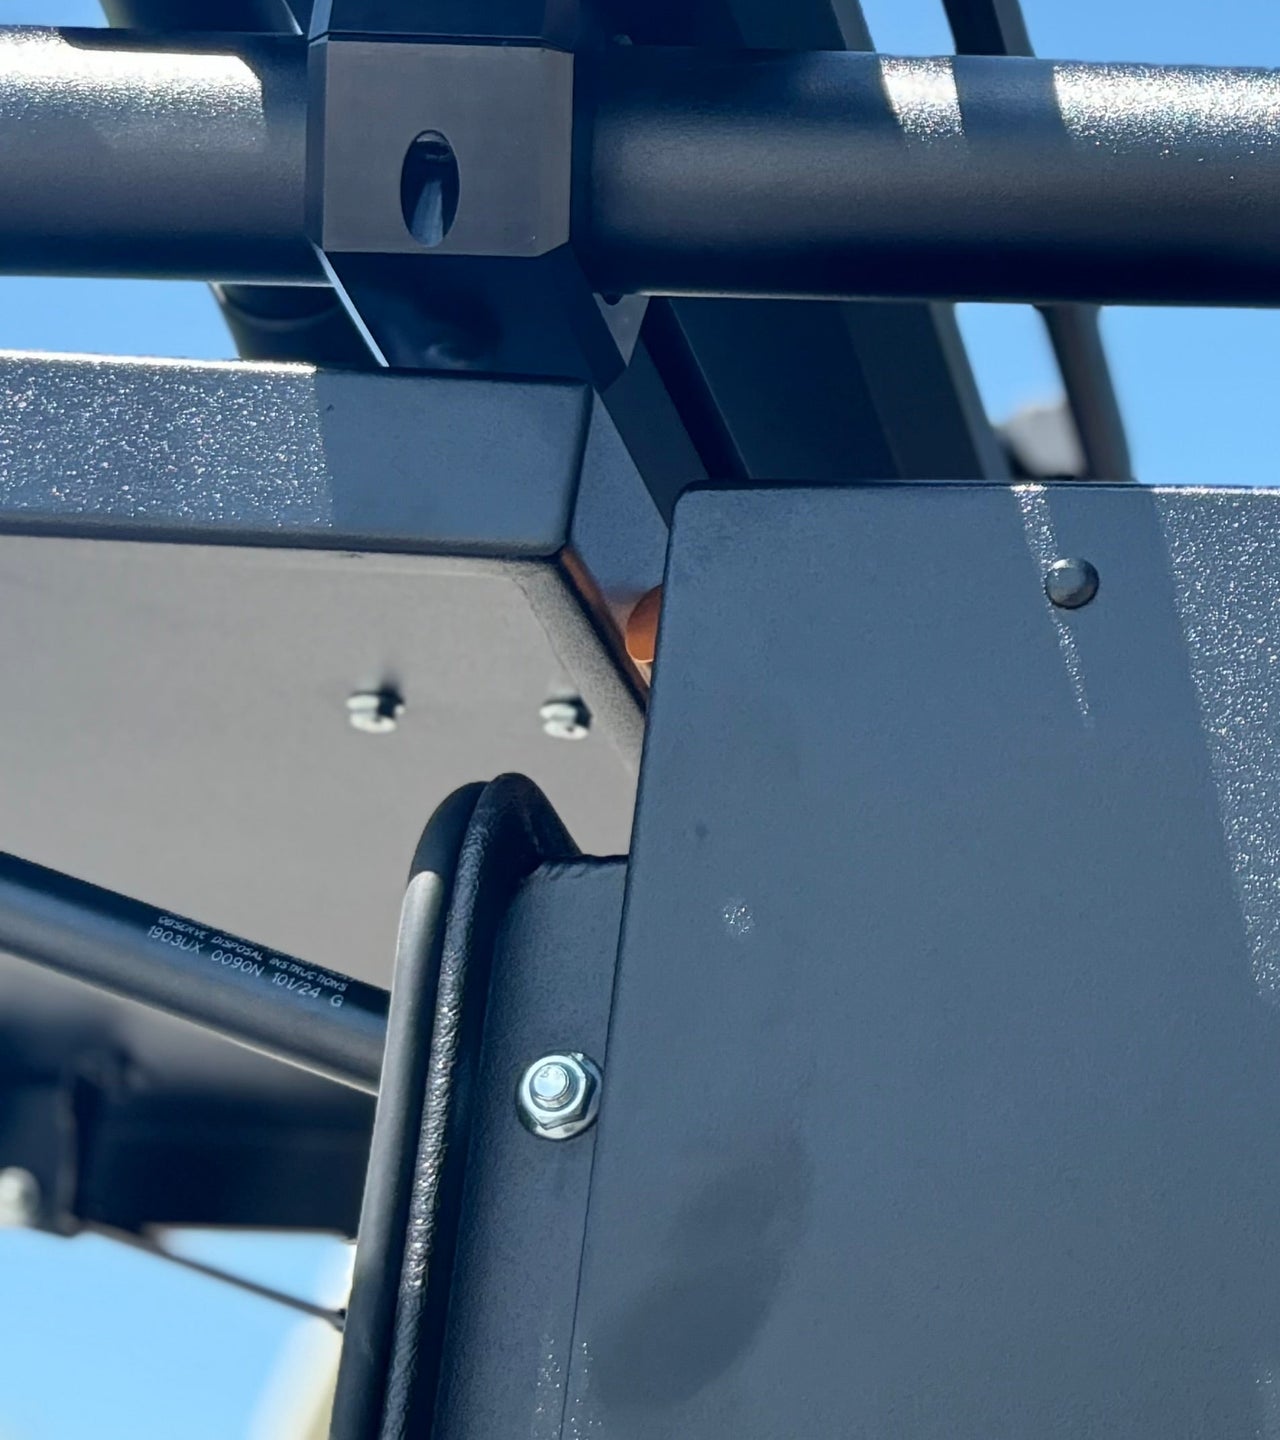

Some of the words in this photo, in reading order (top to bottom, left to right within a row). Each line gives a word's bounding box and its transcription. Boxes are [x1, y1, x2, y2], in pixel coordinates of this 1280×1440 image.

[147, 924, 206, 955] 1903UX
[211, 949, 265, 977] 0090N
[330, 994, 344, 1008] G
[158, 915, 209, 940] OBSERVE
[211, 935, 264, 961] DISPOSAL
[269, 957, 348, 992] INSTRUCTIONS
